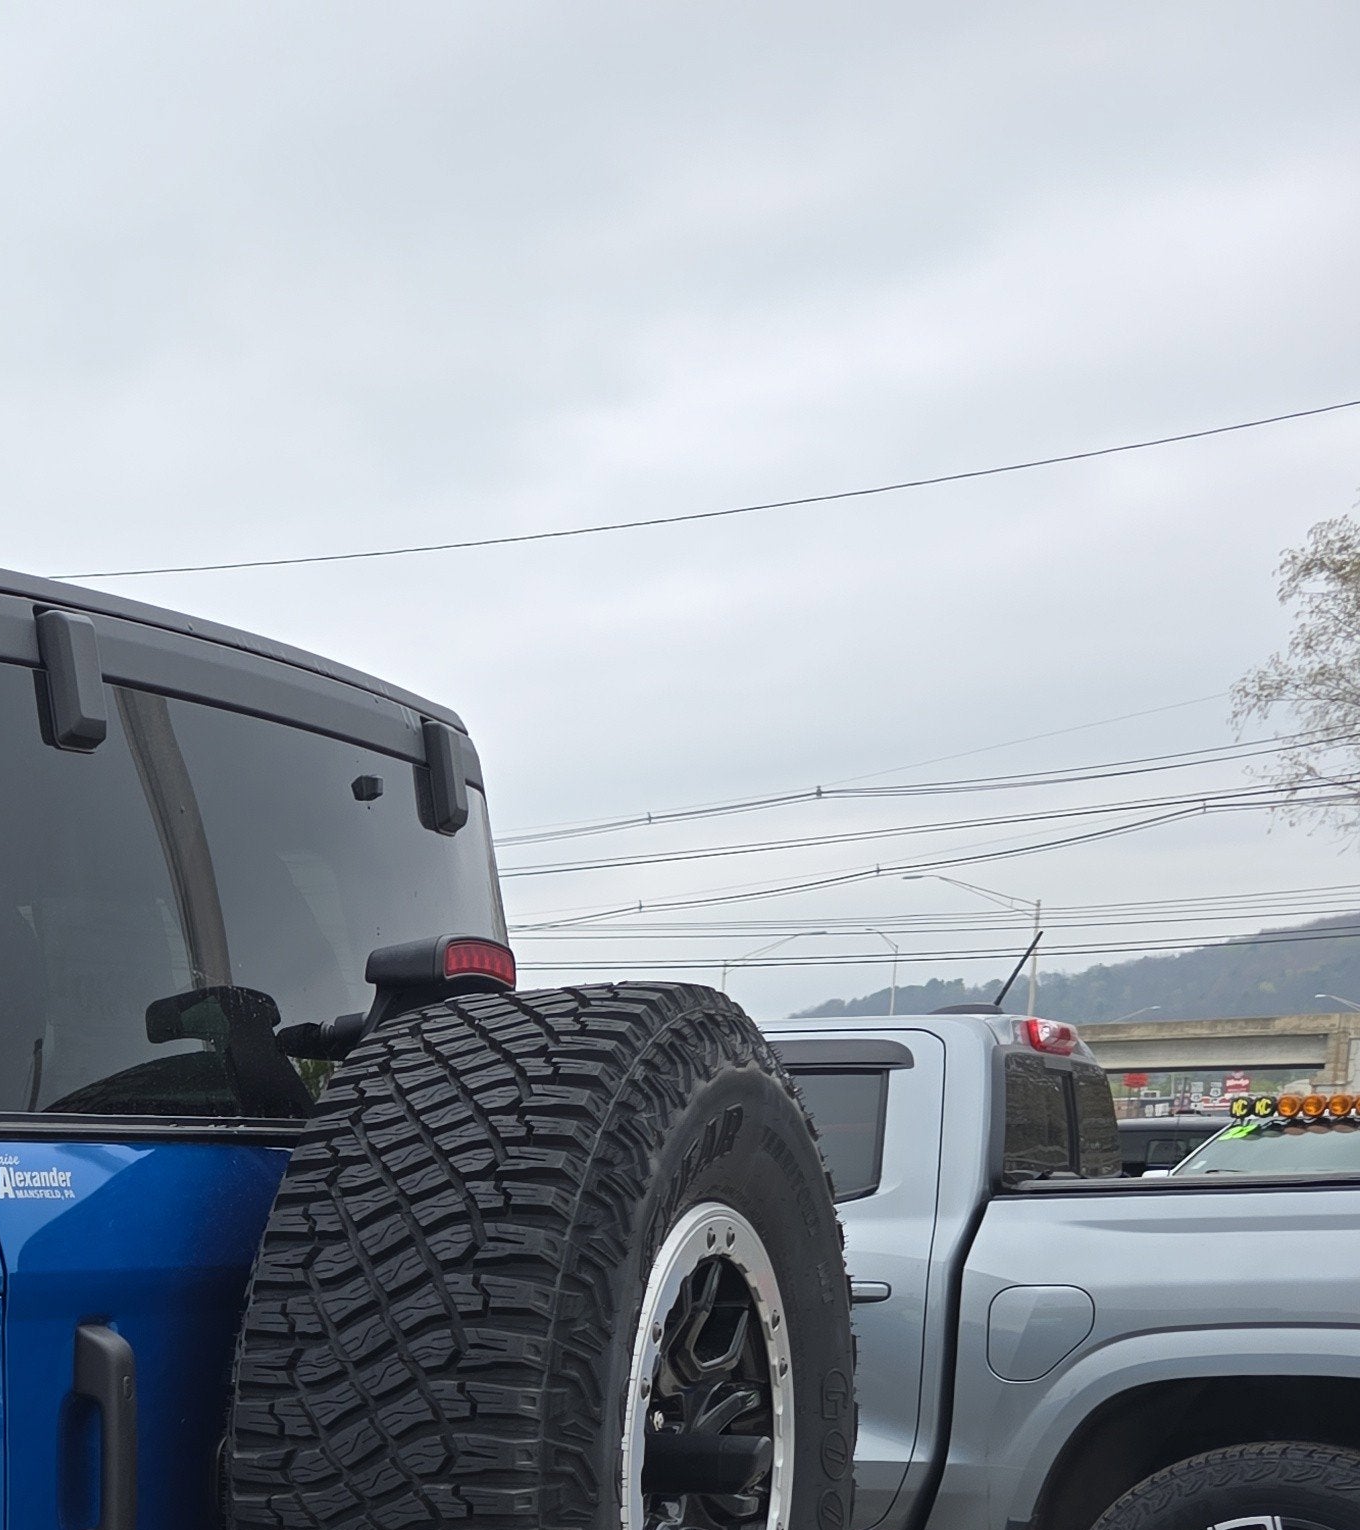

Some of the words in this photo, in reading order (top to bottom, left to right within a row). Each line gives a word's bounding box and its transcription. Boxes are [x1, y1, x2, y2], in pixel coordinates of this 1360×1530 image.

[1231, 1099, 1248, 1117] KC
[1255, 1098, 1272, 1116] KC
[64, 1189, 76, 1199] PA
